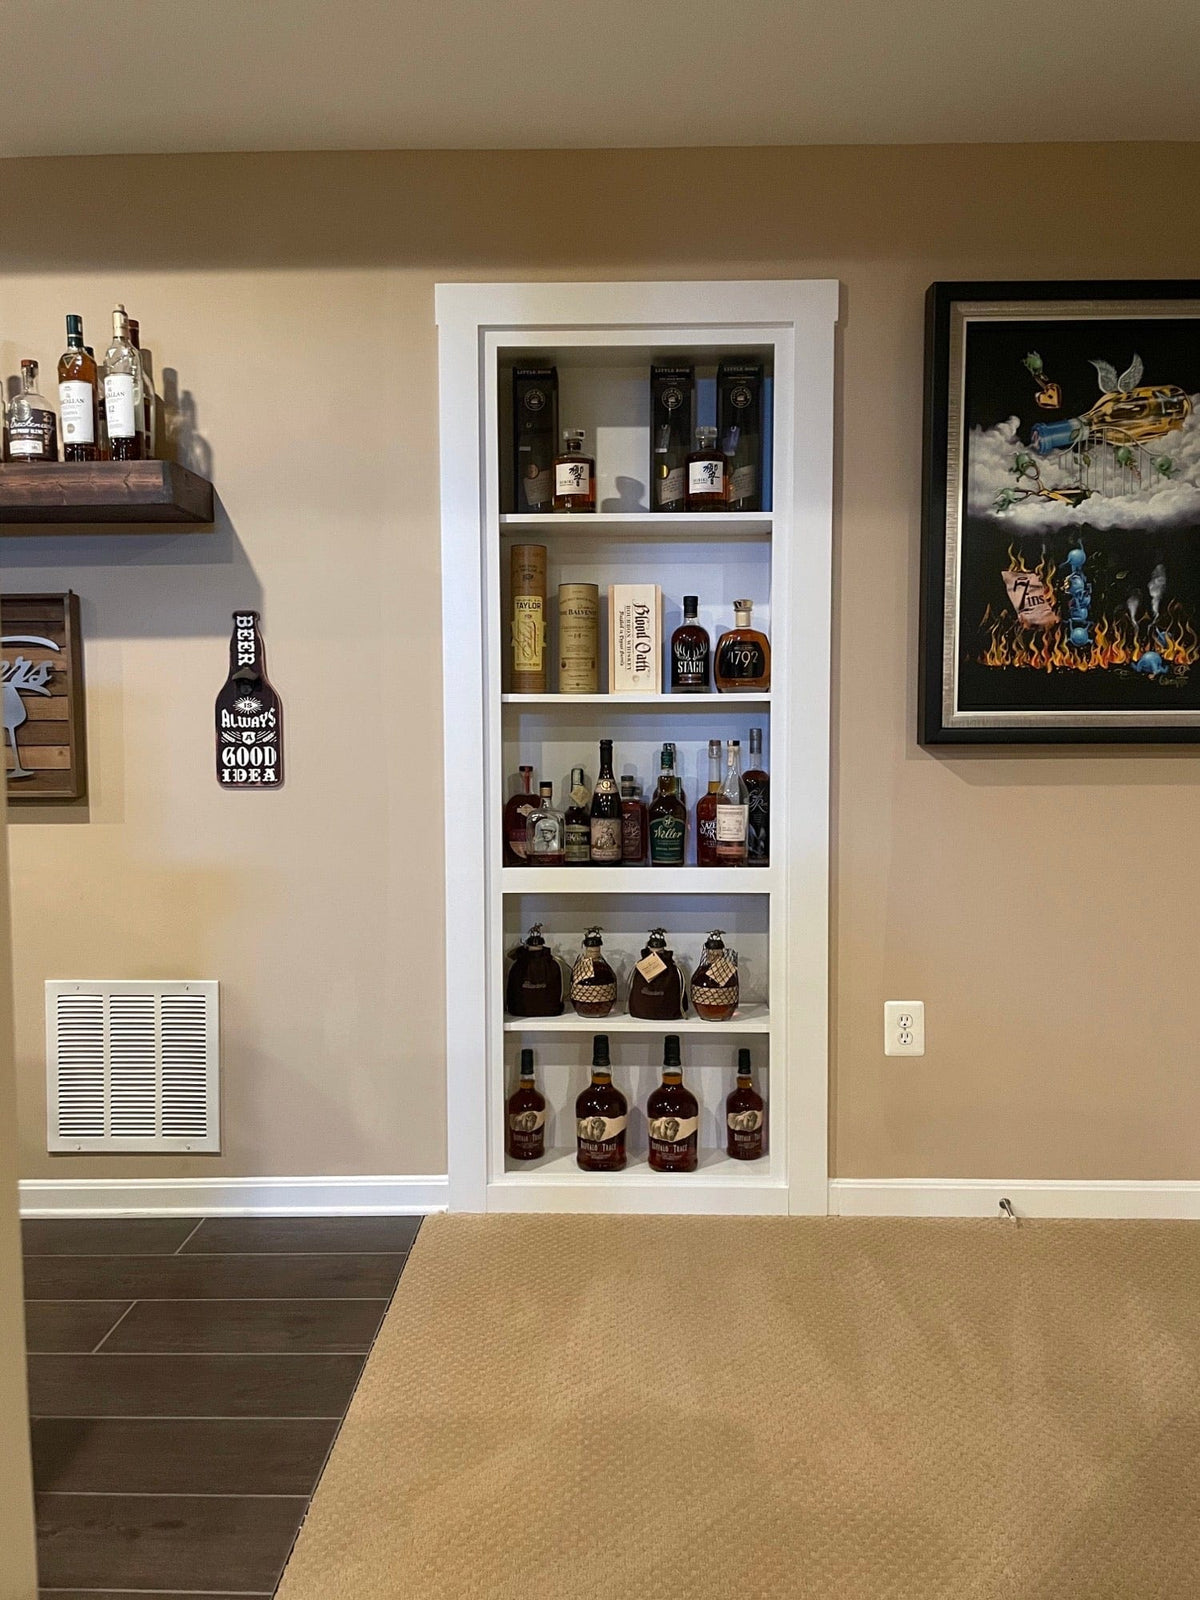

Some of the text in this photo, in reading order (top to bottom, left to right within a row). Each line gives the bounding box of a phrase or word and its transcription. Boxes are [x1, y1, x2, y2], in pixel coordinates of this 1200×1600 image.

[236, 615, 256, 666] BEER
[634, 641, 652, 673] Oath
[729, 650, 759, 668] 1792
[222, 746, 277, 767] GOOD
[653, 825, 682, 840] Weller
